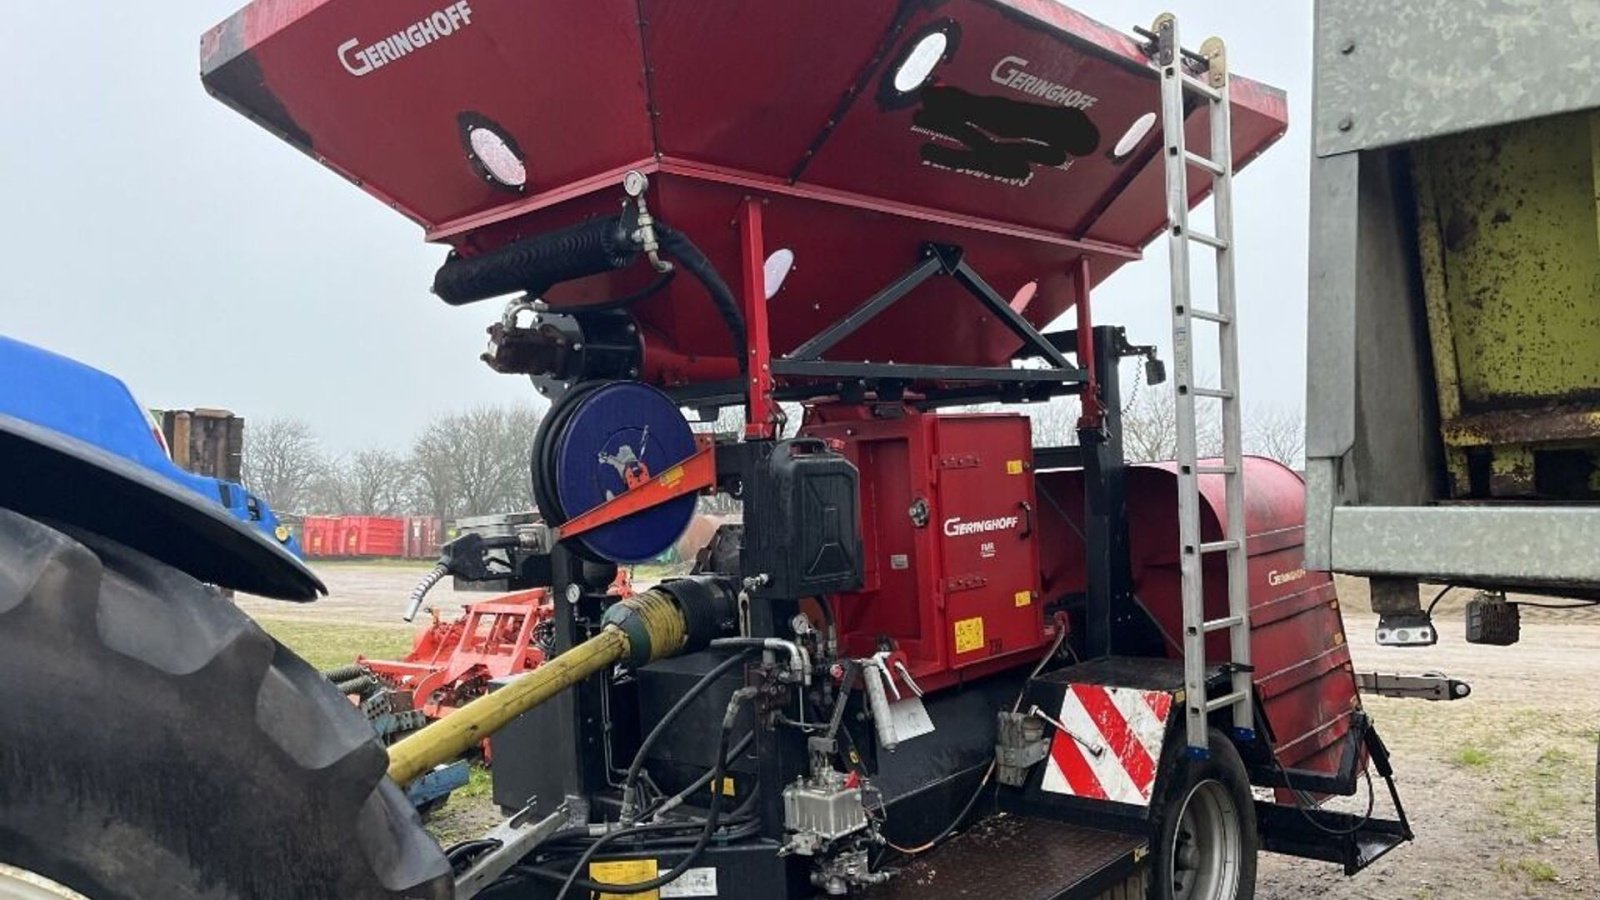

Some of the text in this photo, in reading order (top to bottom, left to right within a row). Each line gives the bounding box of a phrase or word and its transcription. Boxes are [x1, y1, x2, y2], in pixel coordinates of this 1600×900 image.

[337, 0, 472, 76] GERINGHOFF
[991, 56, 1098, 111] GERINGHOFF
[944, 517, 1018, 537] GERINGHOFF
